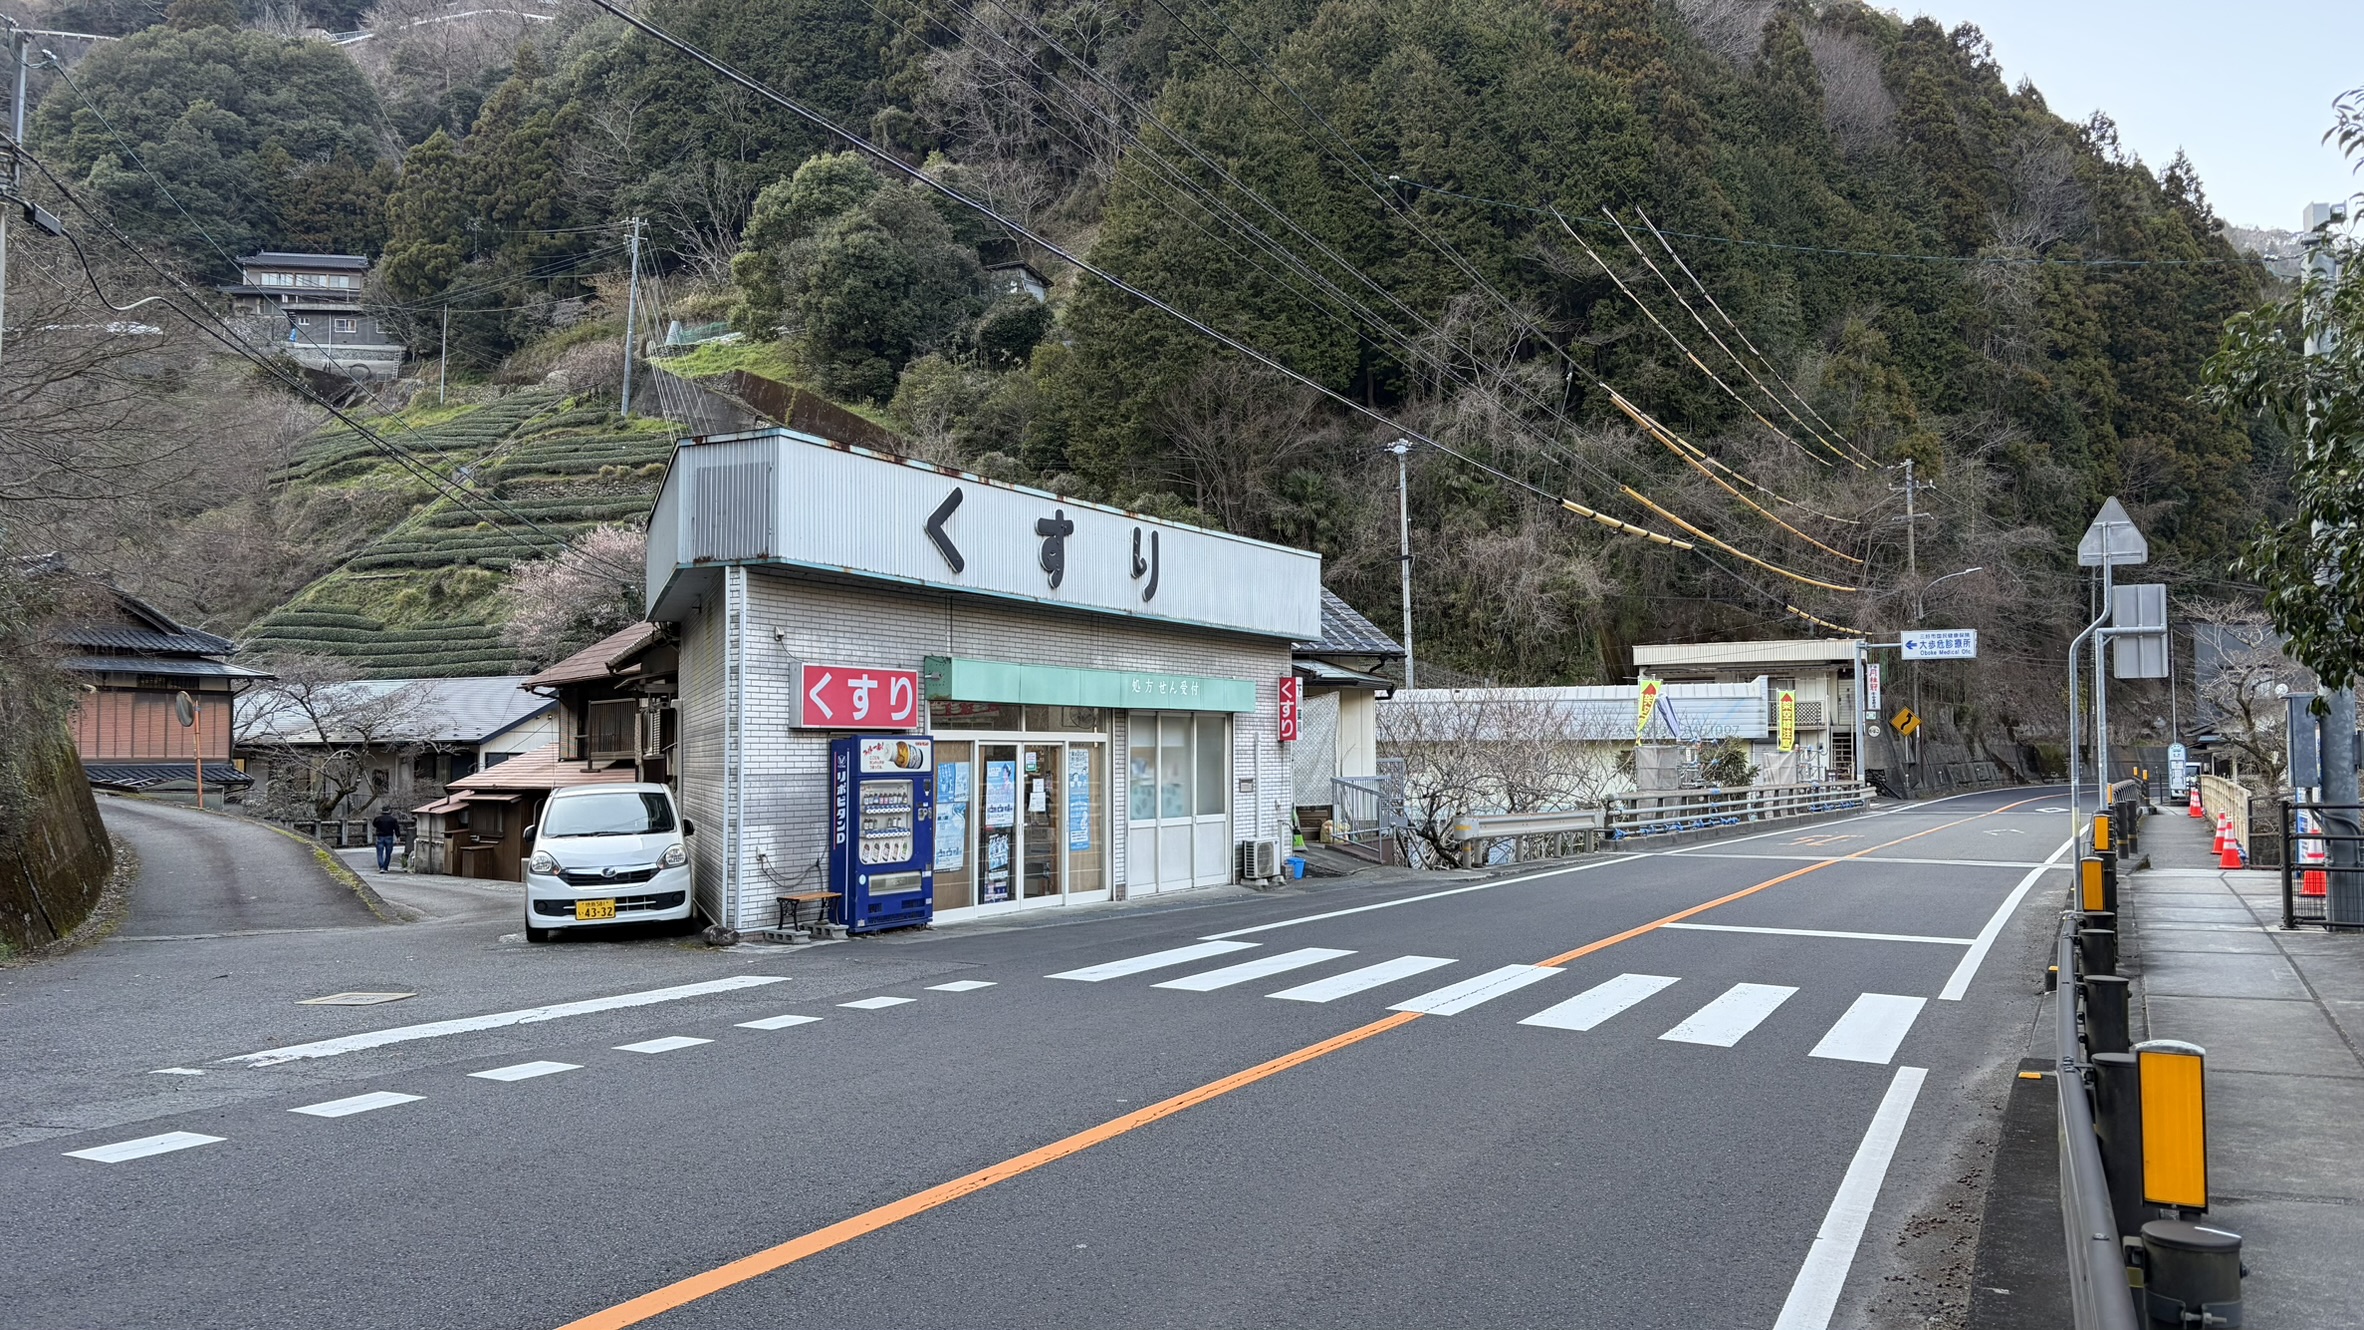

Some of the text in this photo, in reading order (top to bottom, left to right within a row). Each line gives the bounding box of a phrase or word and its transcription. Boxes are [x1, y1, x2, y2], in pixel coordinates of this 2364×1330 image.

[923, 486, 1159, 602] くすり
[1919, 639, 1971, 649] 大歩危診療所
[809, 671, 913, 721] くすり
[1132, 678, 1199, 696] 処方せん受付
[1280, 680, 1294, 738] くすり
[837, 771, 846, 844] リポビタンD
[585, 906, 613, 918] 43-32
